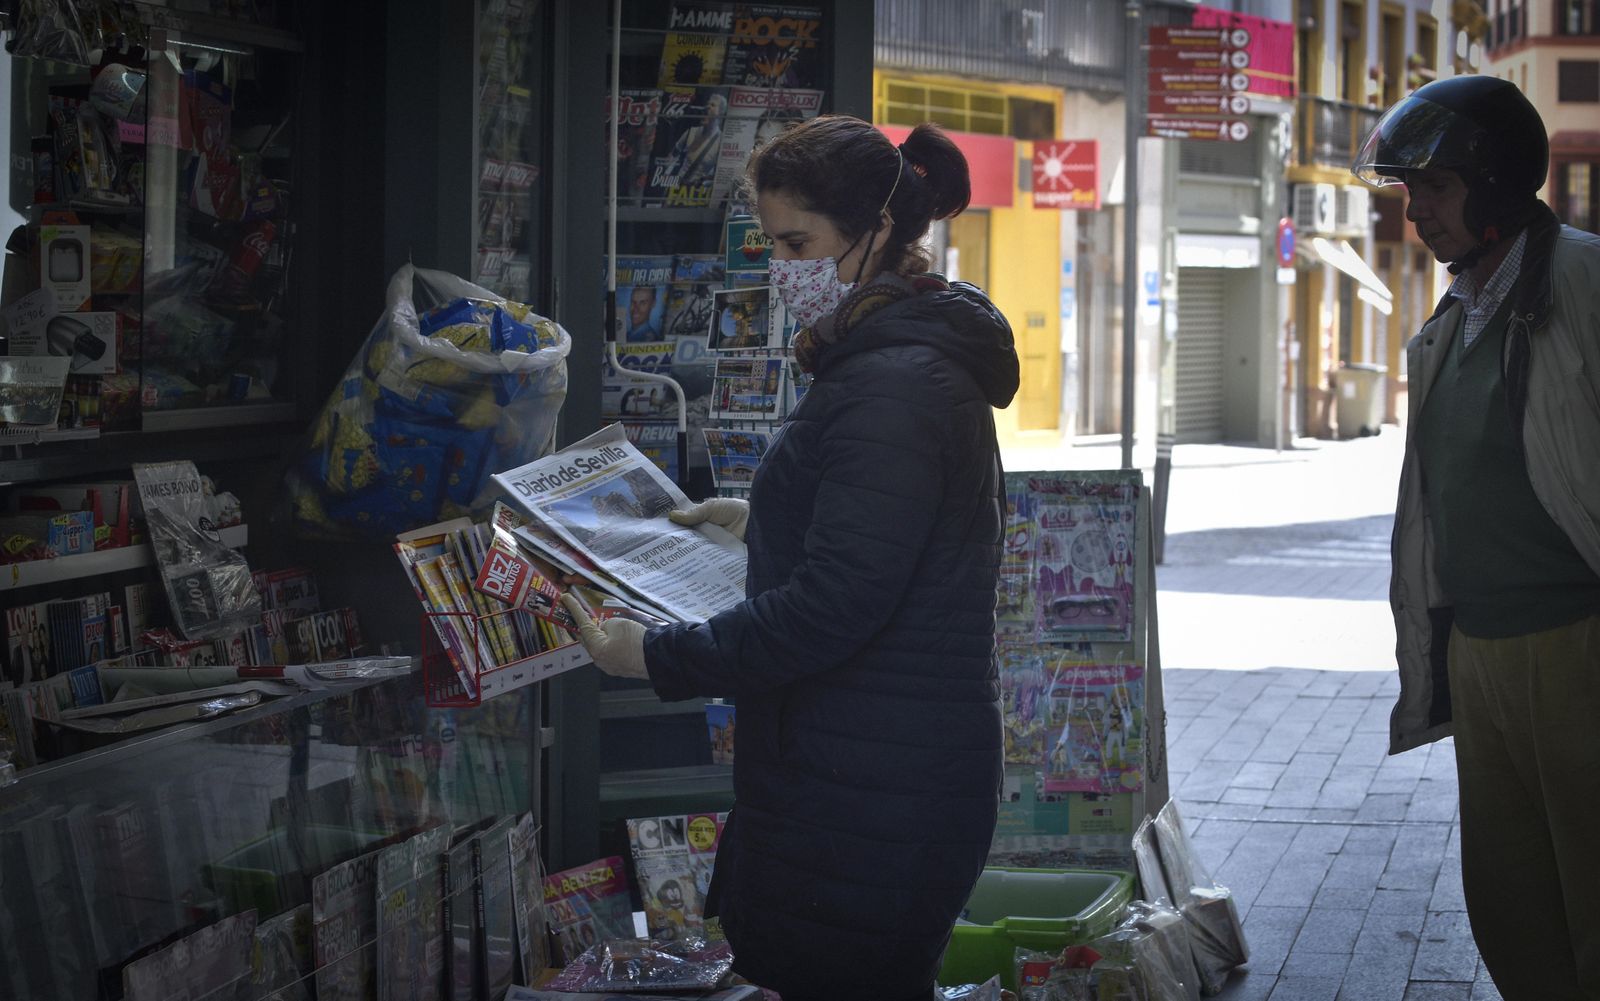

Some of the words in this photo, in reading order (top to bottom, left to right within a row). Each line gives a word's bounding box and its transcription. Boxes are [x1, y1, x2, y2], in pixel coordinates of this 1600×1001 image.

[731, 16, 819, 48] ROCK
[512, 473, 562, 498] Diario
[559, 465, 581, 484] de
[575, 446, 629, 475] Sevilla
[143, 482, 171, 499] JAMES
[172, 480, 199, 495] BOND
[640, 538, 676, 562] prorroga
[660, 556, 668, 569] el
[482, 553, 513, 596] DIEZ
[500, 561, 521, 600] MINUTOS
[561, 866, 616, 894] BELLEZA
